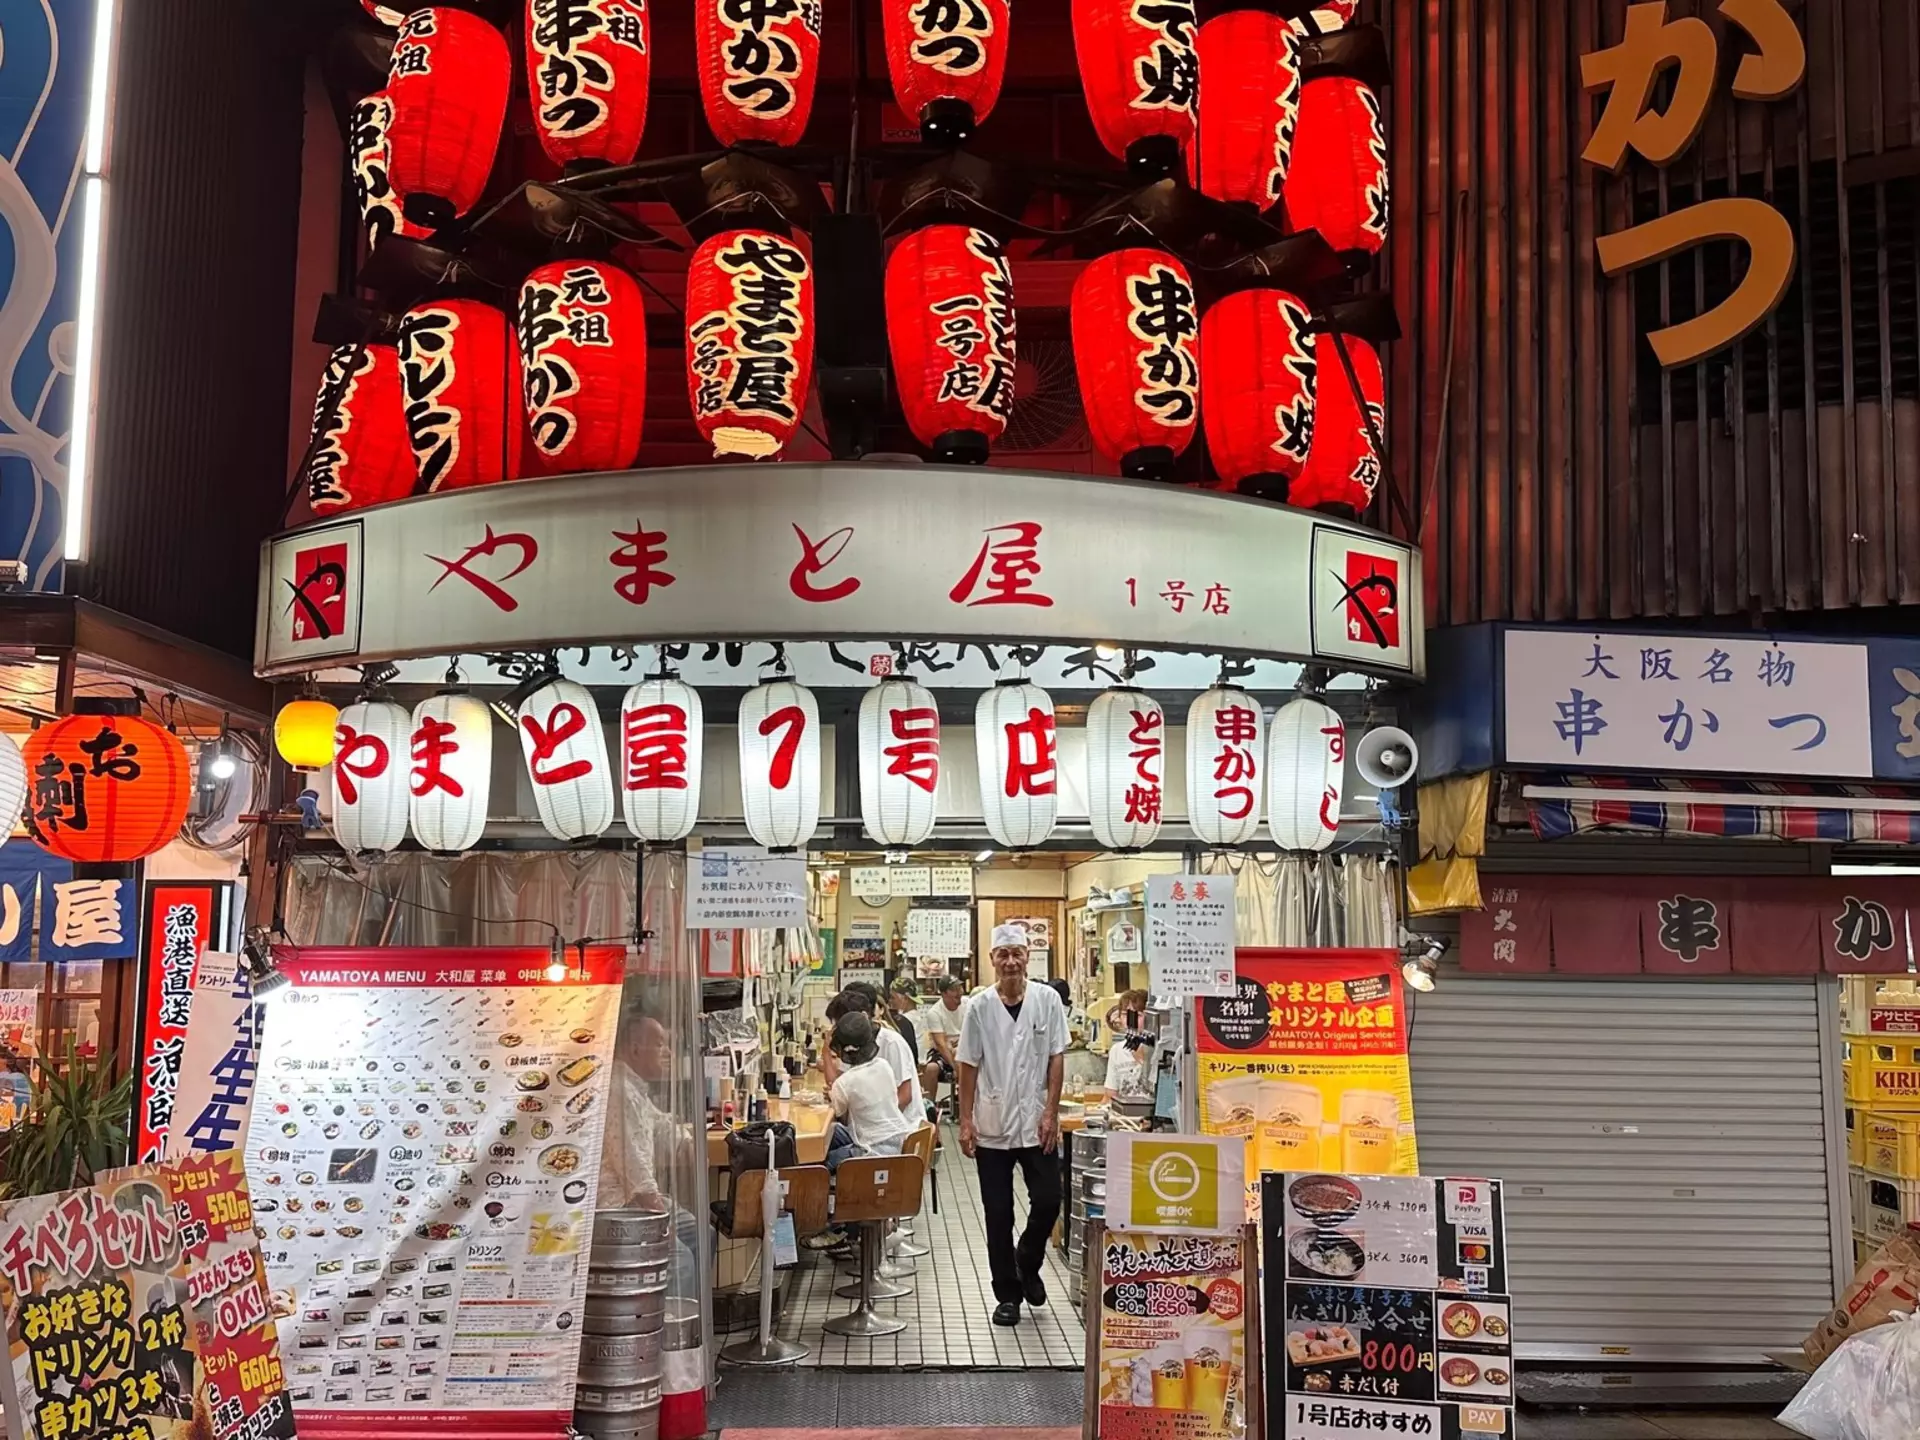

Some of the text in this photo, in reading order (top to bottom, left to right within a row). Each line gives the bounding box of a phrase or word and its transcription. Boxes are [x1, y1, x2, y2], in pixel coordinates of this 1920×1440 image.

[404, 7, 437, 76] 元祖
[1580, 0, 1806, 368] かつ
[563, 266, 612, 347] 元祖
[714, 233, 809, 423] やまと屋
[929, 294, 986, 403] 一号店
[1126, 263, 1198, 428] 串かつ
[517, 282, 580, 457] 串かつ
[689, 315, 730, 416] 一号店
[423, 518, 1231, 615] やまと屋 1号店
[1581, 643, 1796, 688] 大阪名物
[1552, 688, 1828, 757] 串かつ
[1124, 709, 1164, 825] とて焼
[1213, 705, 1257, 820] 串かつ
[701, 881, 793, 892] お気軽にお入り下さい
[163, 904, 199, 1027] 漁港直送
[199, 974, 232, 988] サントリー
[299, 970, 427, 983] YAMATOYA MENU
[435, 968, 507, 983] 大和屋 菜单
[1219, 1000, 1255, 1017] 名物!
[1266, 980, 1346, 1005] やまと屋
[1267, 1004, 1395, 1029] オリジナル企画
[1268, 1031, 1320, 1039] YAMATOYA
[1322, 1031, 1358, 1041] Original
[1875, 1071, 1920, 1089] KIRI
[168, 1166, 221, 1194] ンセット
[1365, 1199, 1392, 1211] うな丼
[1454, 1204, 1482, 1214] PayPay
[1463, 1225, 1488, 1236] VISA
[1106, 1238, 1214, 1278] 飲み放題
[1366, 1251, 1429, 1265] うどん 360円
[23, 1281, 131, 1343] お好きな
[217, 1281, 267, 1338] OK!
[1306, 1285, 1414, 1308] やまと屋1号店
[1291, 1303, 1433, 1333] にぎり盛合せ
[33, 1310, 184, 1392] ドリンク 2杯
[1363, 1340, 1435, 1373] 800円
[1339, 1373, 1400, 1396] 赤だし付
[39, 1367, 165, 1440] 串カツ3本
[1297, 1402, 1433, 1435] 1号店おすすめ
[1468, 1409, 1497, 1425] PAY
